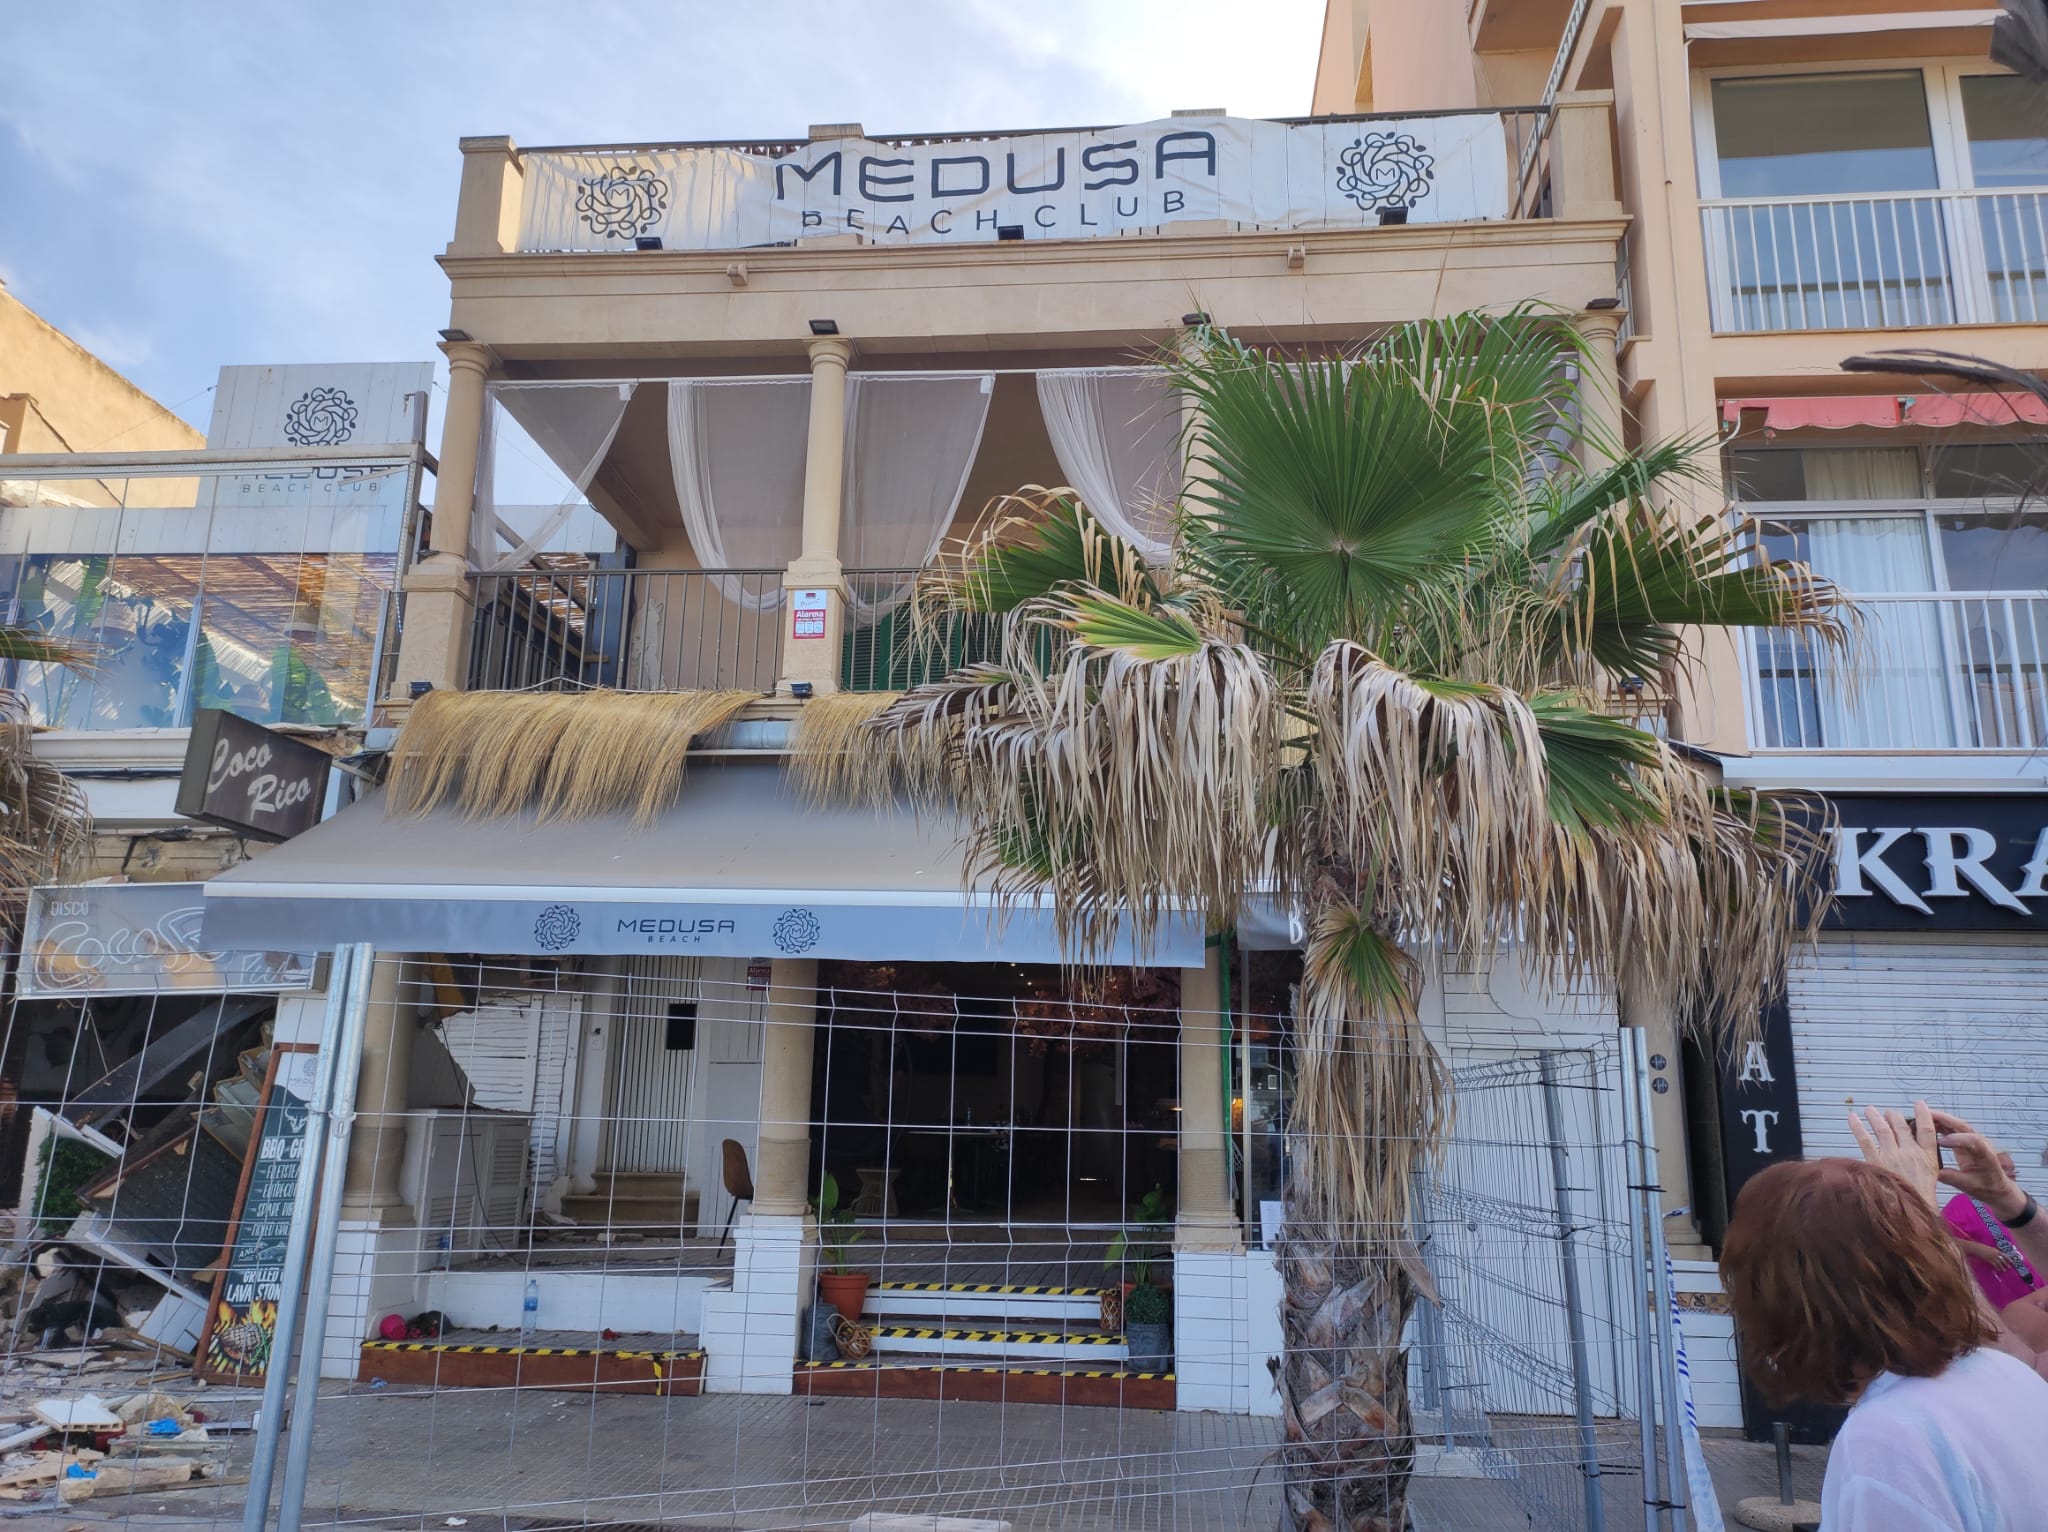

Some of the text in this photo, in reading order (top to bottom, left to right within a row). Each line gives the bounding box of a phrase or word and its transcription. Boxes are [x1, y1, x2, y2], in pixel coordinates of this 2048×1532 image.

[776, 131, 1216, 202] MEDUSA
[802, 190, 1185, 234] BEACH CLUB
[242, 482, 377, 493] BEACH CLUB
[207, 738, 272, 794] Coco
[247, 773, 311, 822] Rico
[50, 901, 89, 916] DISCO
[617, 919, 735, 933] MEDUSA
[647, 935, 701, 943] BEACH
[35, 921, 158, 990] Coco
[226, 1284, 253, 1302] LAVA
